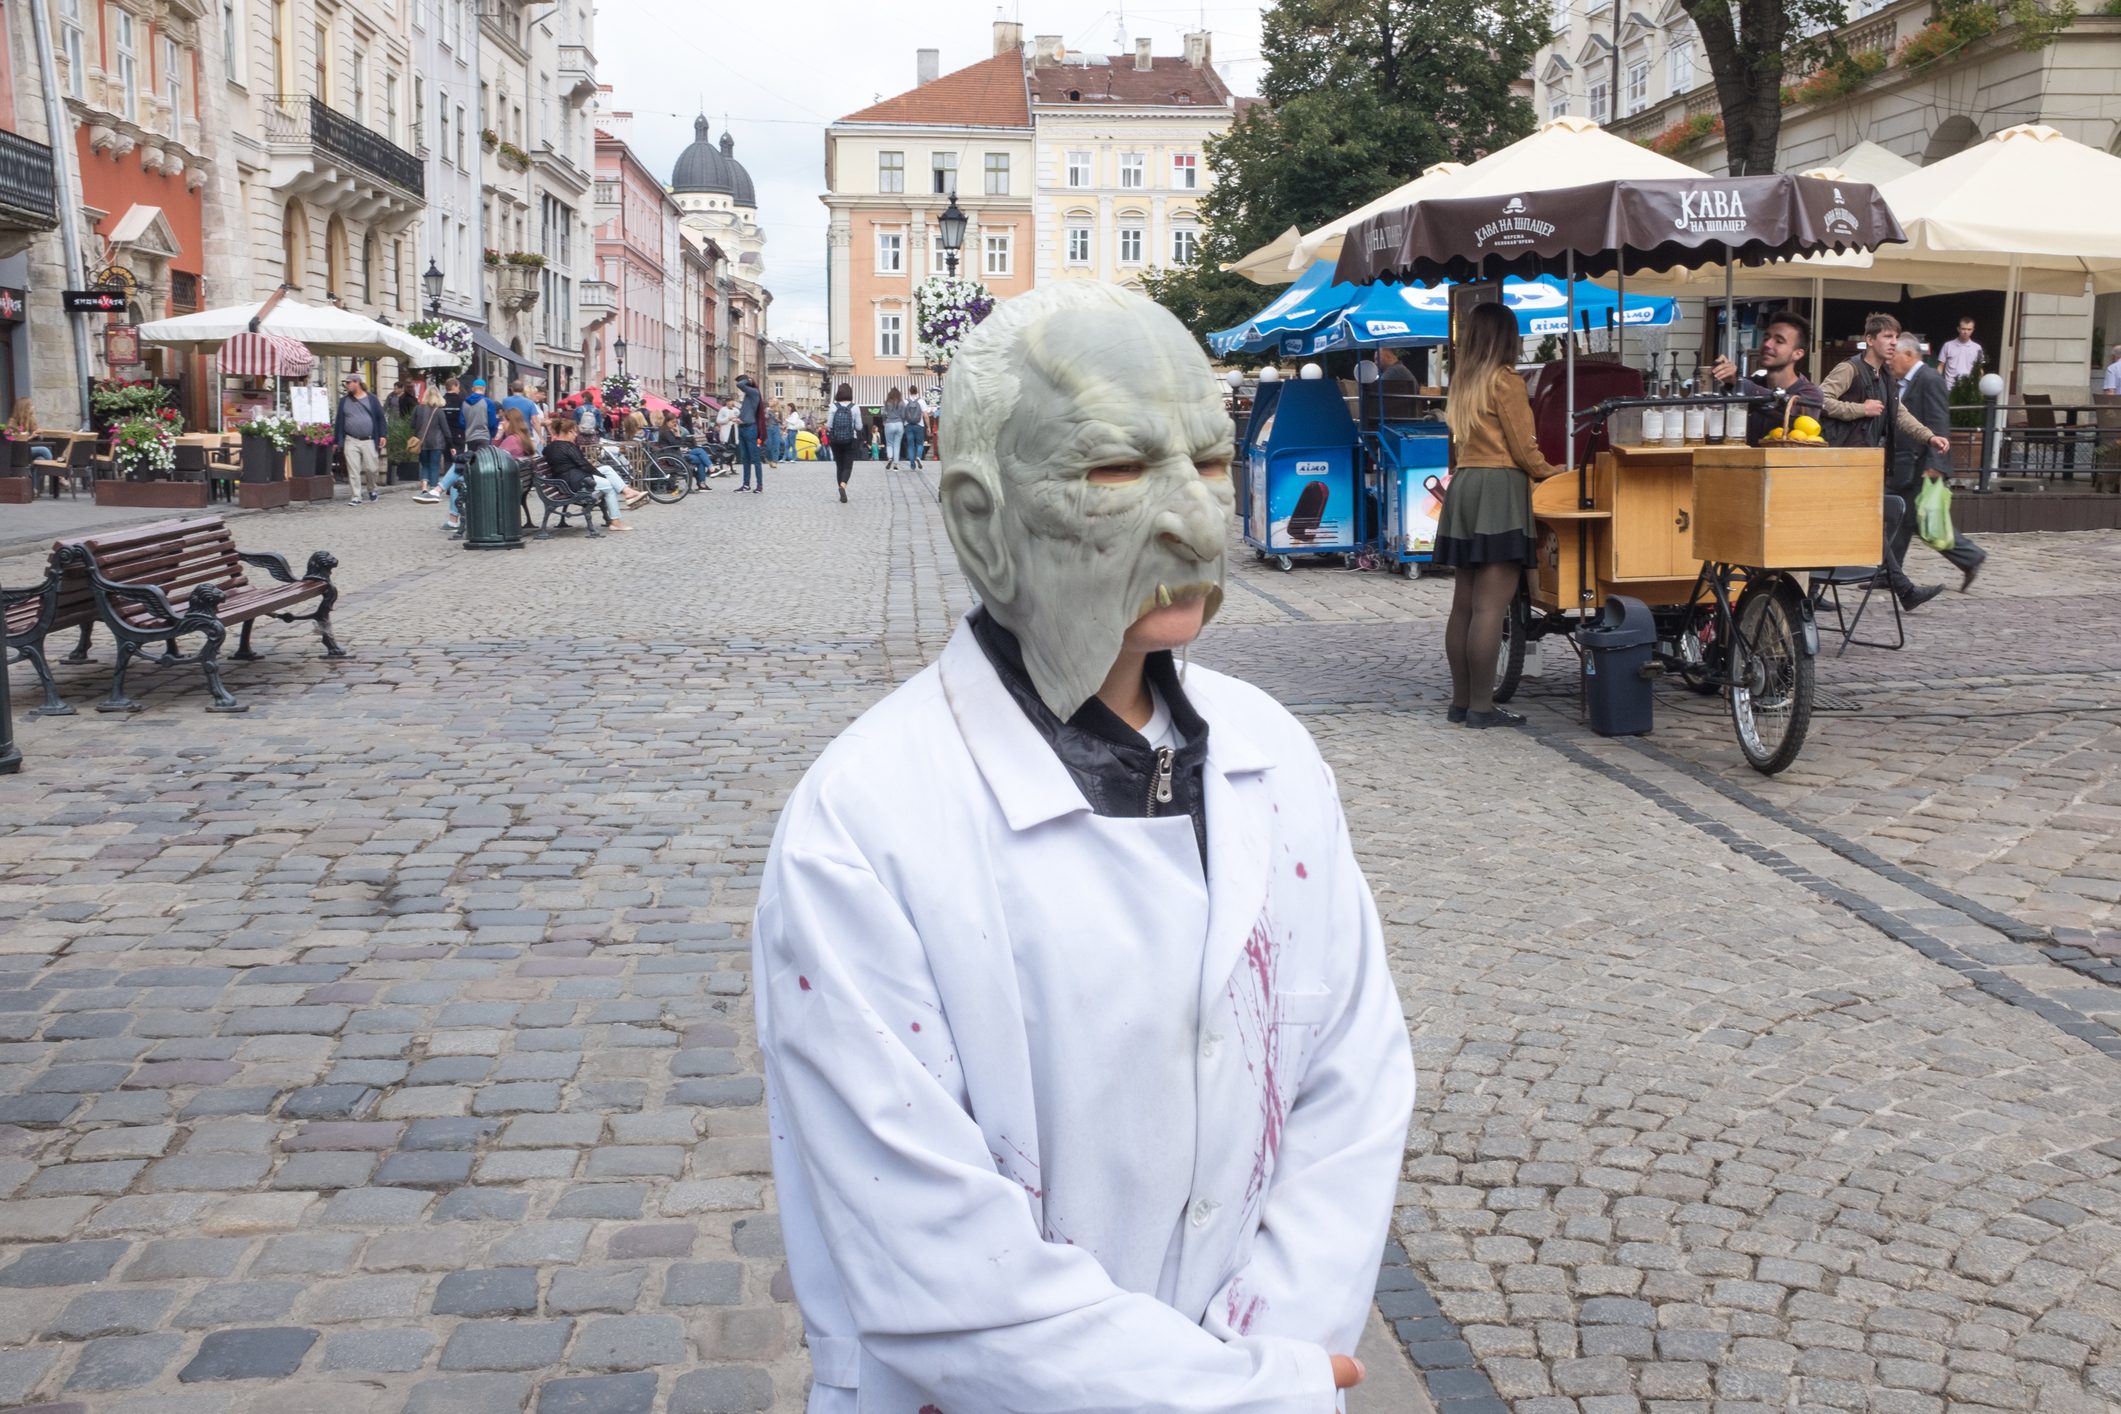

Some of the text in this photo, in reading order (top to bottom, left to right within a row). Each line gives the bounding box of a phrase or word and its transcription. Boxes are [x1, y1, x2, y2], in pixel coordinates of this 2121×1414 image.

[1675, 190, 1746, 229] КАВА
[1475, 217, 1555, 247] КАВА НА ШПАЦЕР
[1690, 220, 1747, 233] НА ШПАЦЕР
